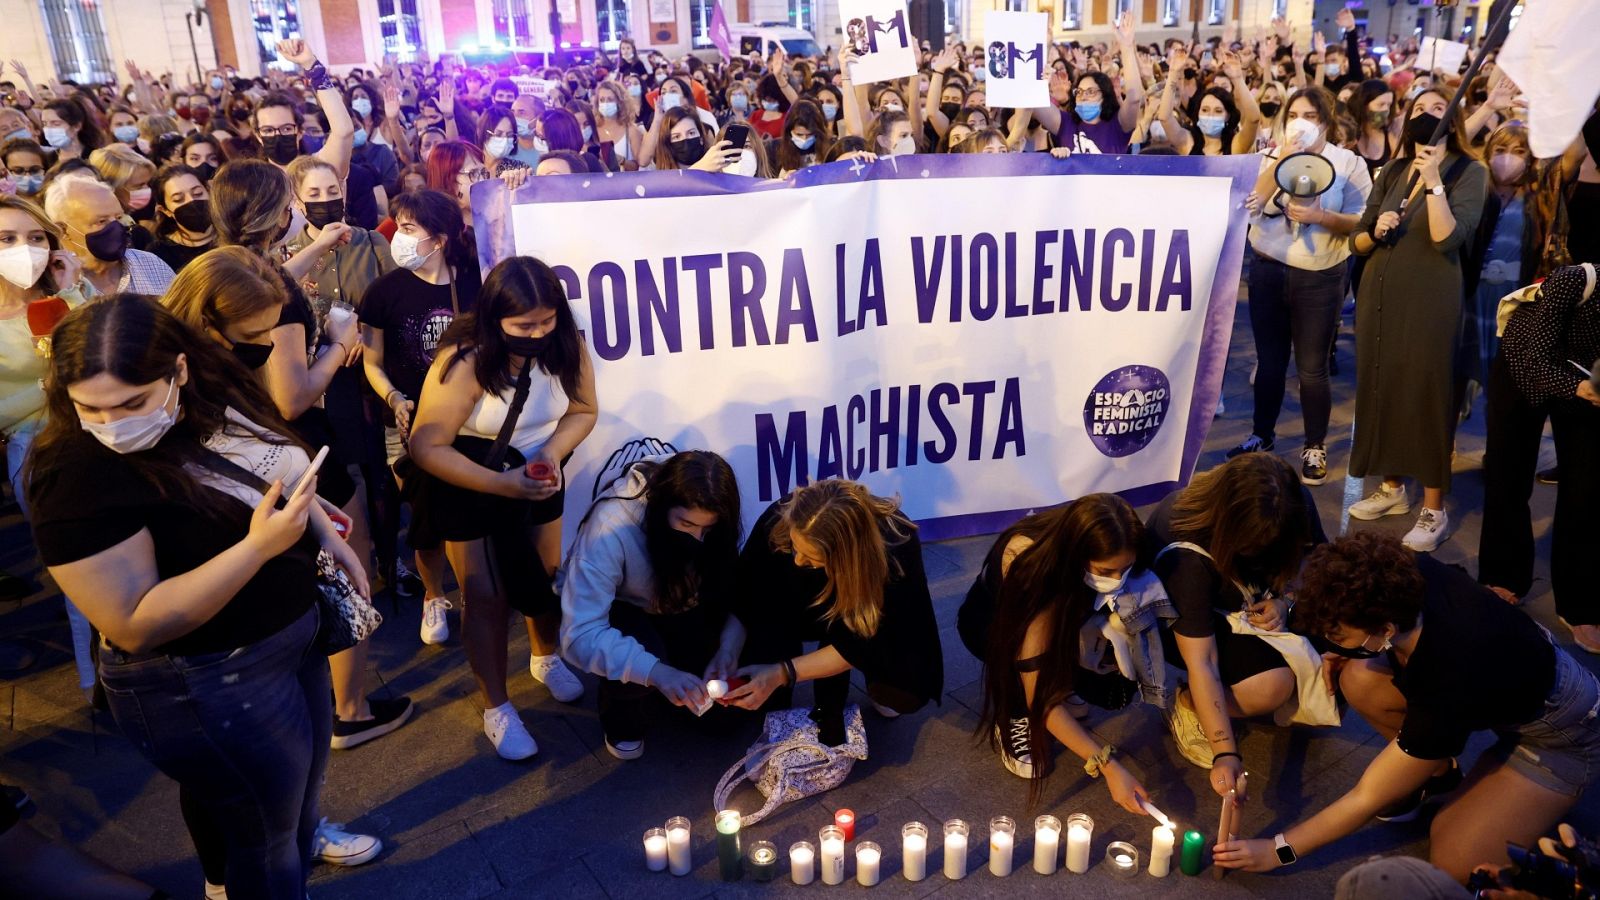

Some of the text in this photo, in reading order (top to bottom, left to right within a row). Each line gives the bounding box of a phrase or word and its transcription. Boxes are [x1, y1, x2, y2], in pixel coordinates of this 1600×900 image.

[988, 40, 1044, 80] 8M
[836, 238, 888, 337] LA
[910, 228, 1192, 324] VIOLENCIA
[1093, 402, 1162, 420] FEMINISTA
[1094, 388, 1166, 407] ESPACIO
[755, 377, 1026, 502] MACHISTA
[1093, 415, 1160, 435] RADICAL
